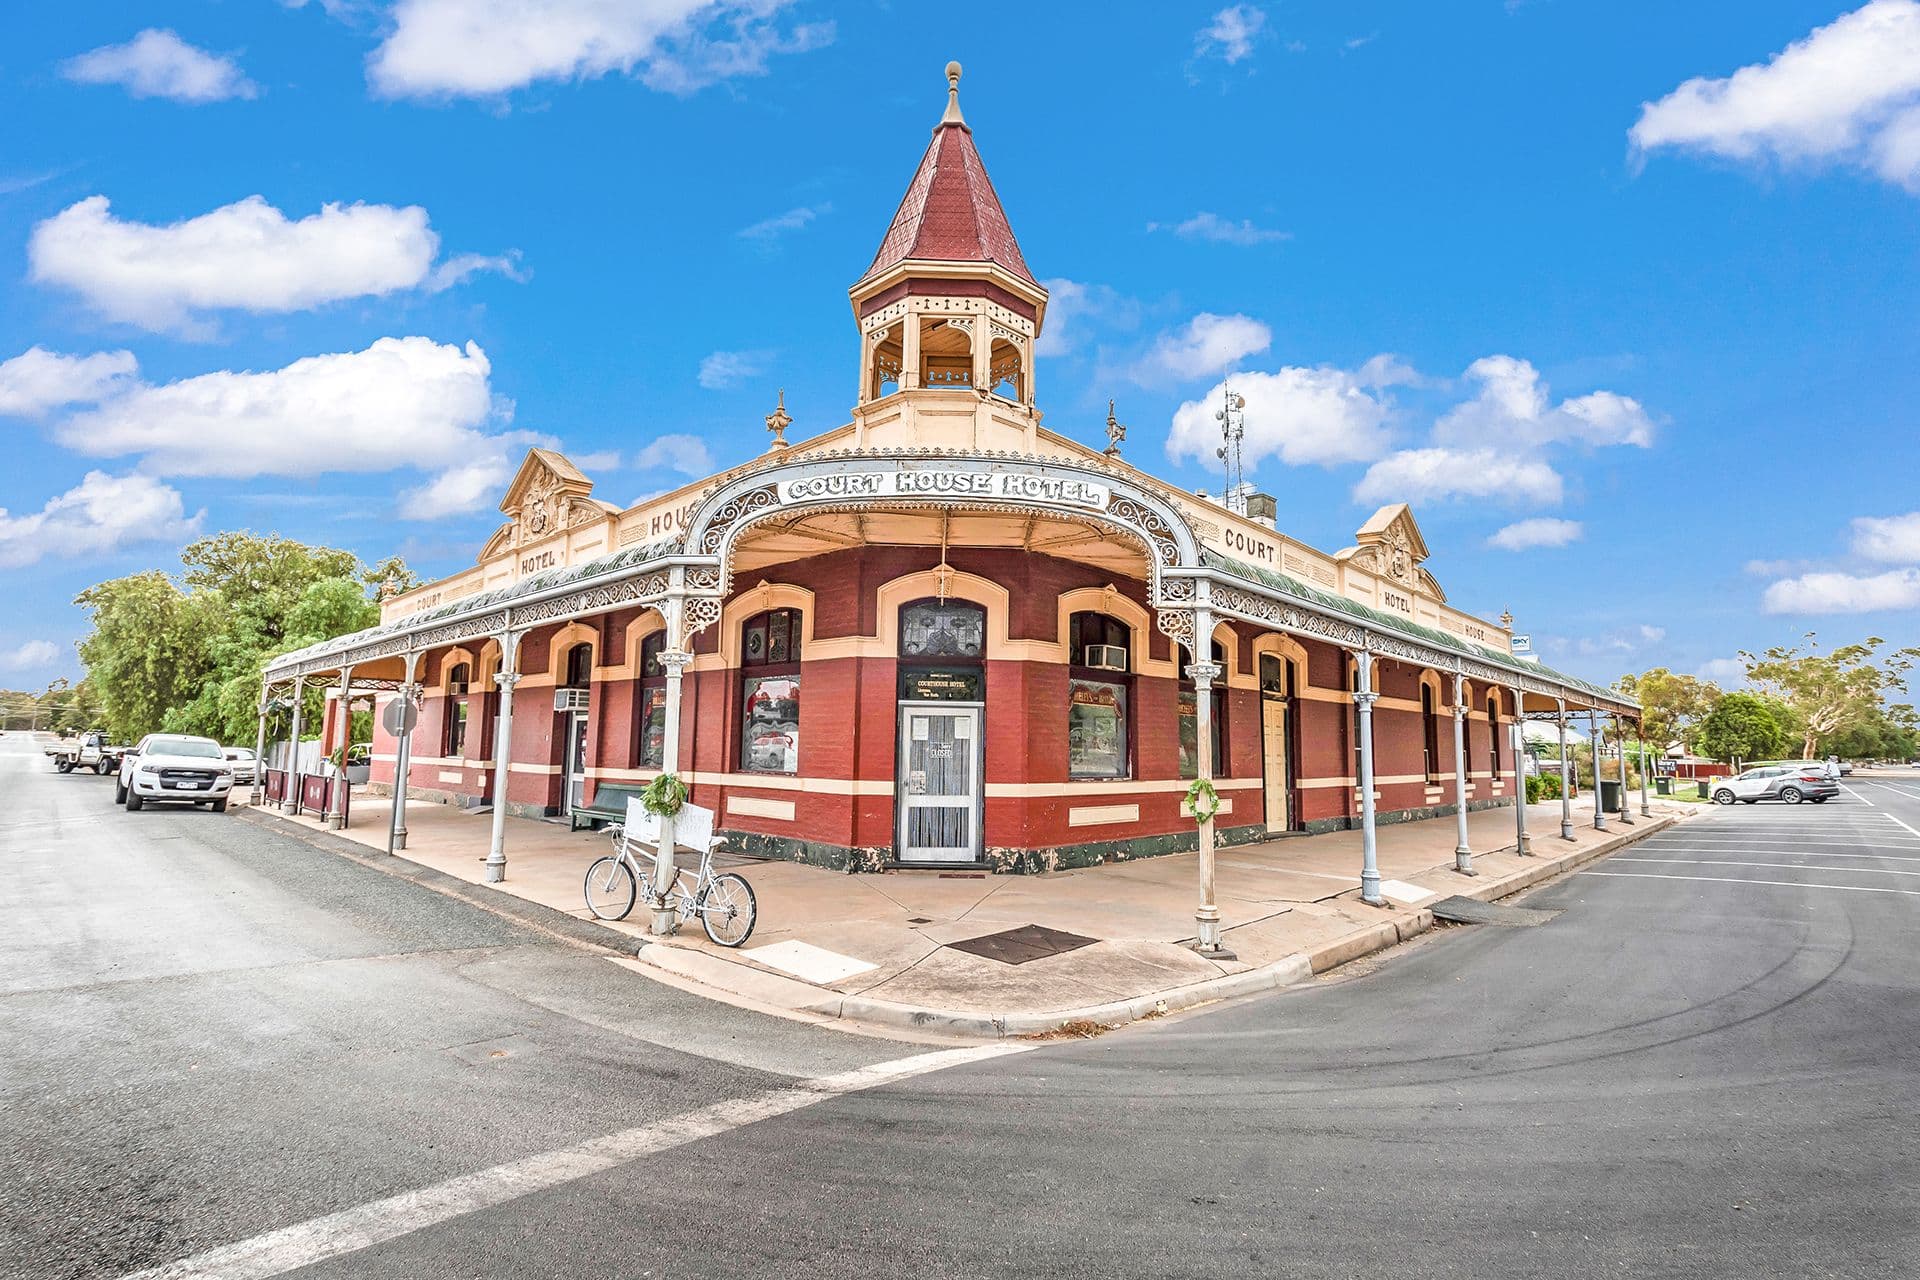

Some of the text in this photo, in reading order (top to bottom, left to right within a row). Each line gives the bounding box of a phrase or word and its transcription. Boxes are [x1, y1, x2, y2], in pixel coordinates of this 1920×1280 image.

[788, 472, 1100, 506] COURT HOUSE HOTEL
[1225, 528, 1274, 563] COURT
[521, 551, 555, 575] HOTEL
[416, 592, 442, 611] COURT
[1384, 591, 1411, 614] HOTEL
[1464, 624, 1485, 642] HOUSE
